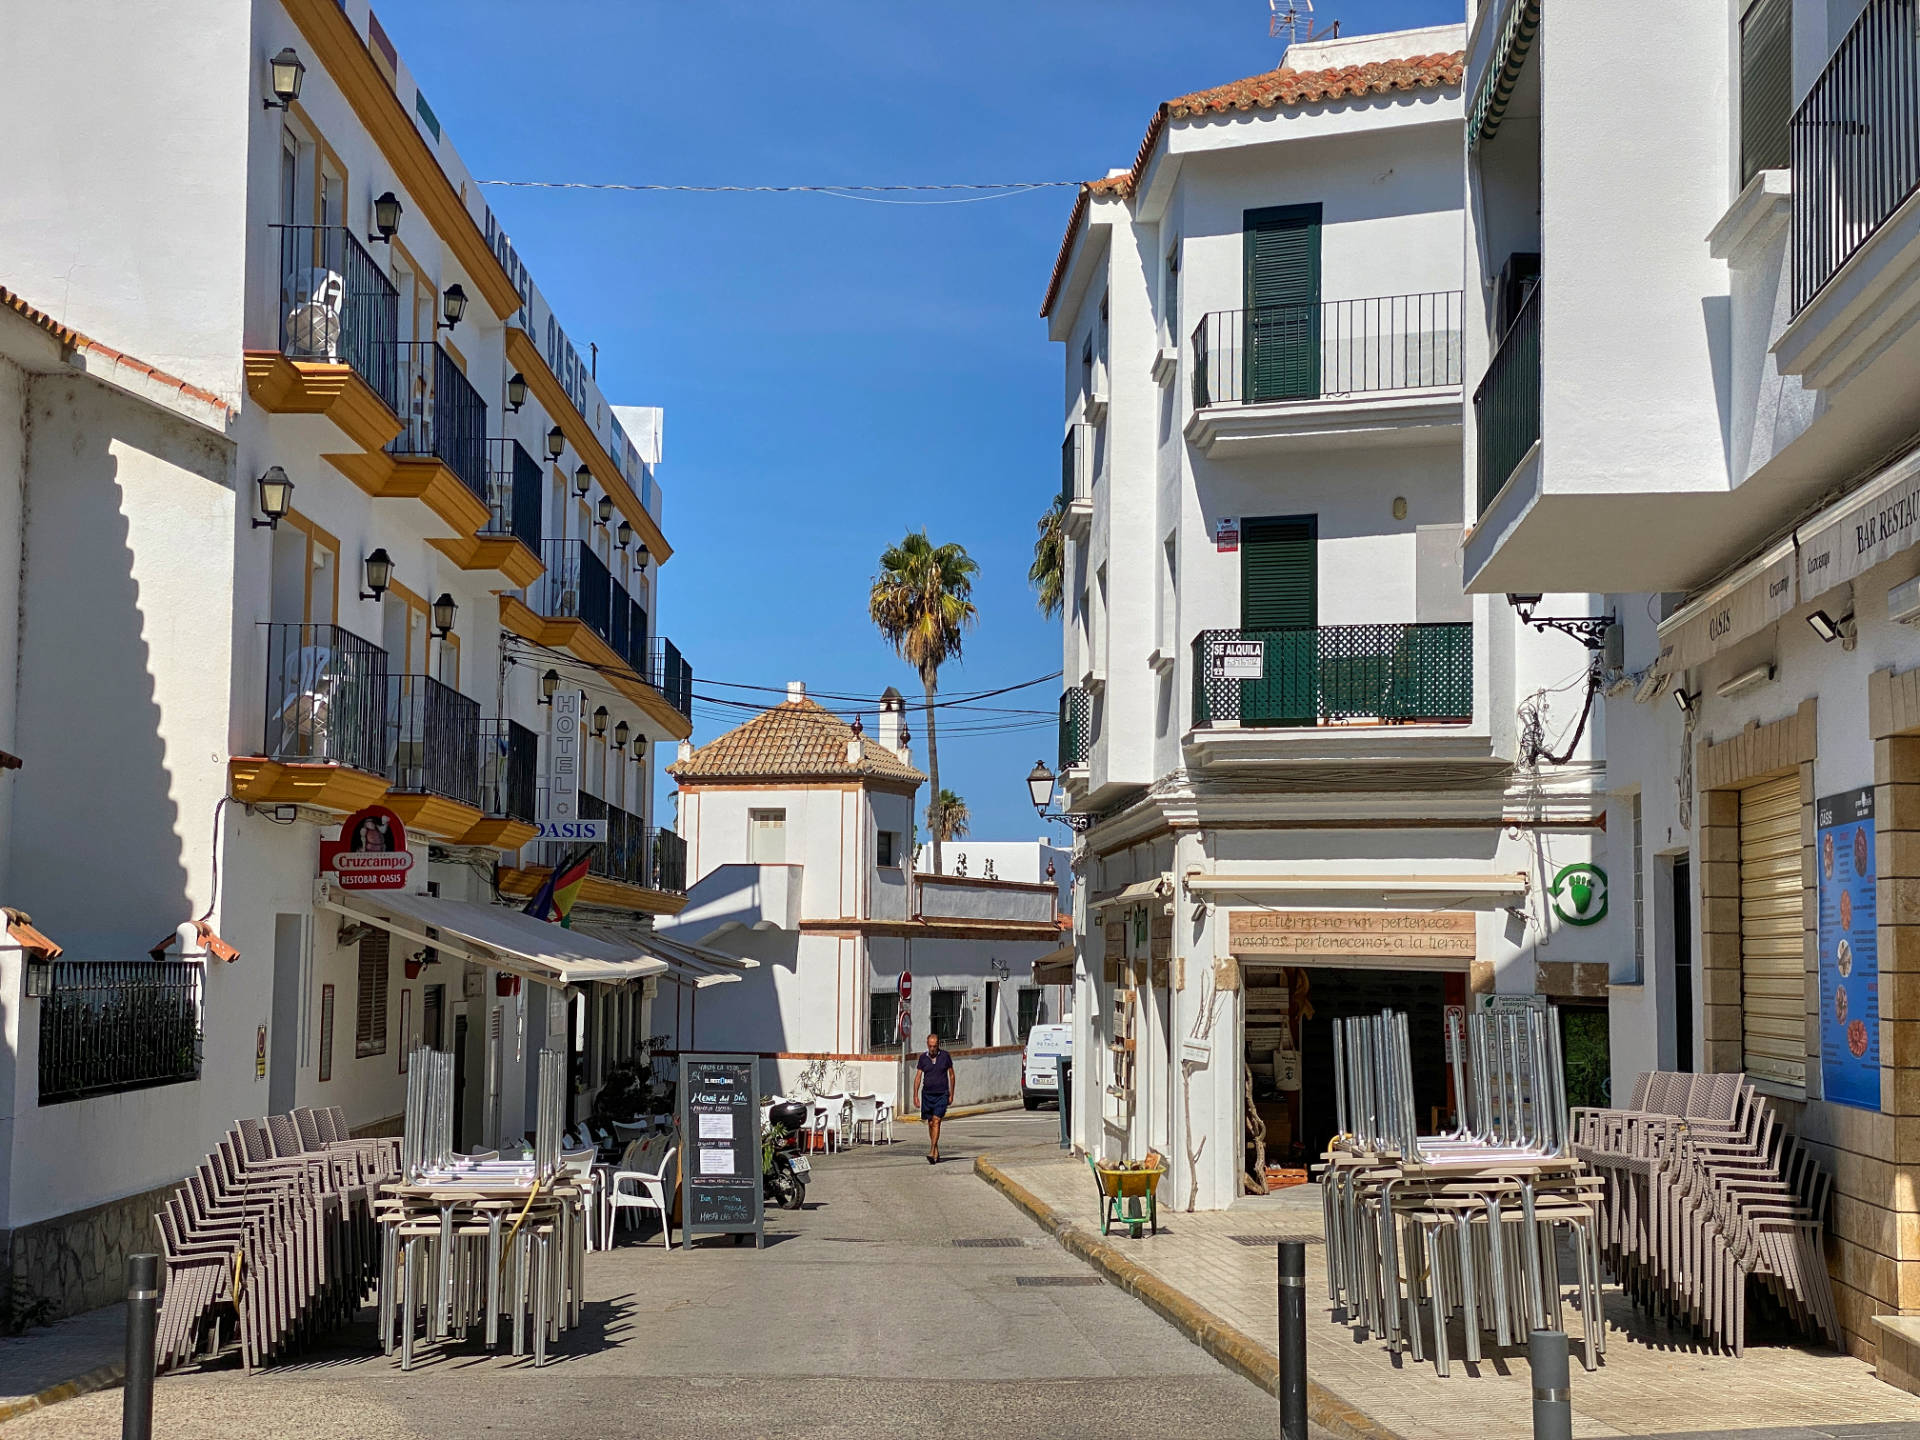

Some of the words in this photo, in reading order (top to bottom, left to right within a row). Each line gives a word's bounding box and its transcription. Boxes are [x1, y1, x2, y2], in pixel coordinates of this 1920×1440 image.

[485, 204, 536, 344] HOTEL
[547, 313, 587, 419] OASIS
[1856, 516, 1876, 554] BAR
[1709, 608, 1731, 642] OASIS
[1214, 644, 1224, 655] SE
[1226, 644, 1261, 656] ALQUILA
[554, 695, 574, 794] HOTEL
[535, 822, 597, 838] OASIS
[338, 855, 407, 868] Cruzcampo
[341, 875, 377, 885] RESTOBAR
[380, 874, 401, 883] OASIS
[1249, 914, 1268, 928] La
[1275, 914, 1318, 928] tierra
[1325, 917, 1342, 928] no
[1348, 917, 1372, 928] nos
[1381, 914, 1450, 933] pertenece
[1295, 934, 1390, 952] pertenecemos
[1394, 938, 1404, 949] a
[1409, 935, 1422, 949] la
[1429, 936, 1470, 949] tierra
